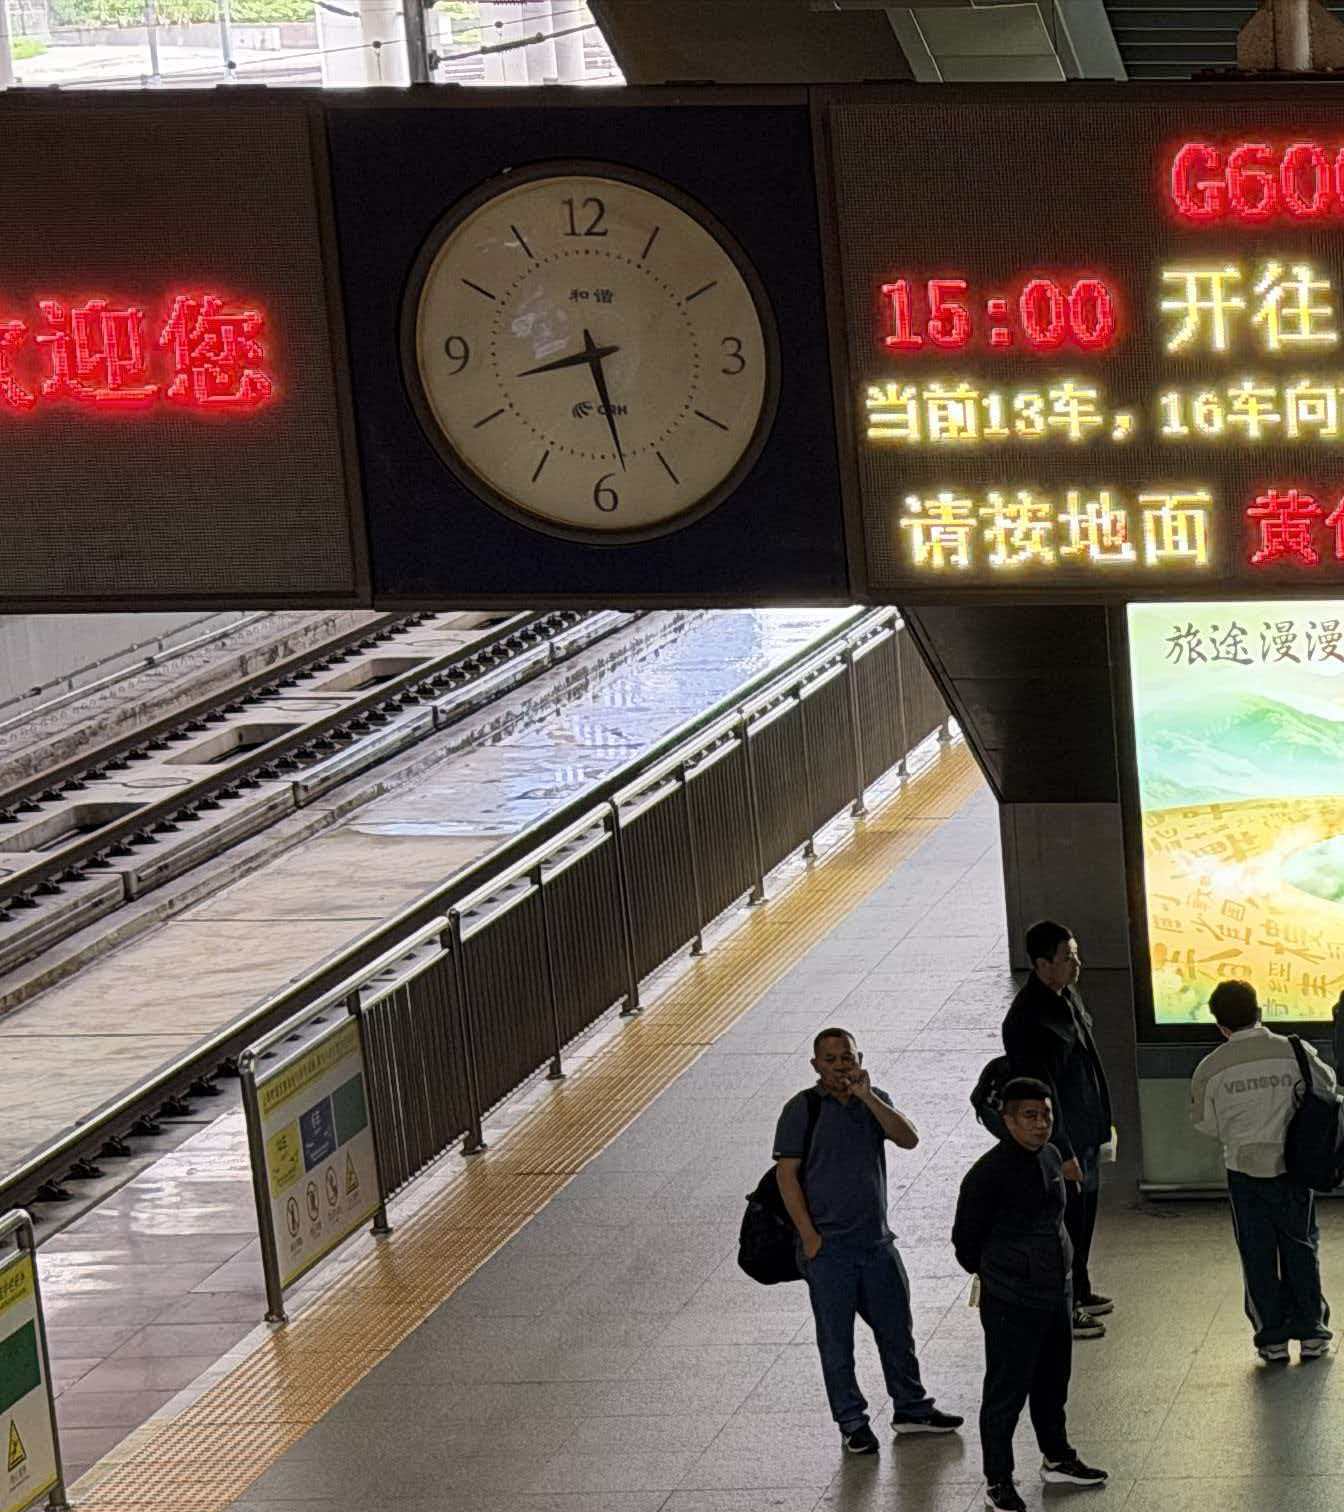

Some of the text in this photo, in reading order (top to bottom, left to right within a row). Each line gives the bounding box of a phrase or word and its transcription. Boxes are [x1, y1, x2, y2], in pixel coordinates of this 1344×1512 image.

[561, 198, 609, 237] 12
[882, 278, 1115, 350] 15:00
[1160, 260, 1339, 354] 开往
[445, 336, 470, 375] 9
[722, 336, 746, 375] 3
[593, 473, 619, 513] 6
[899, 488, 1213, 570] 请按地面
